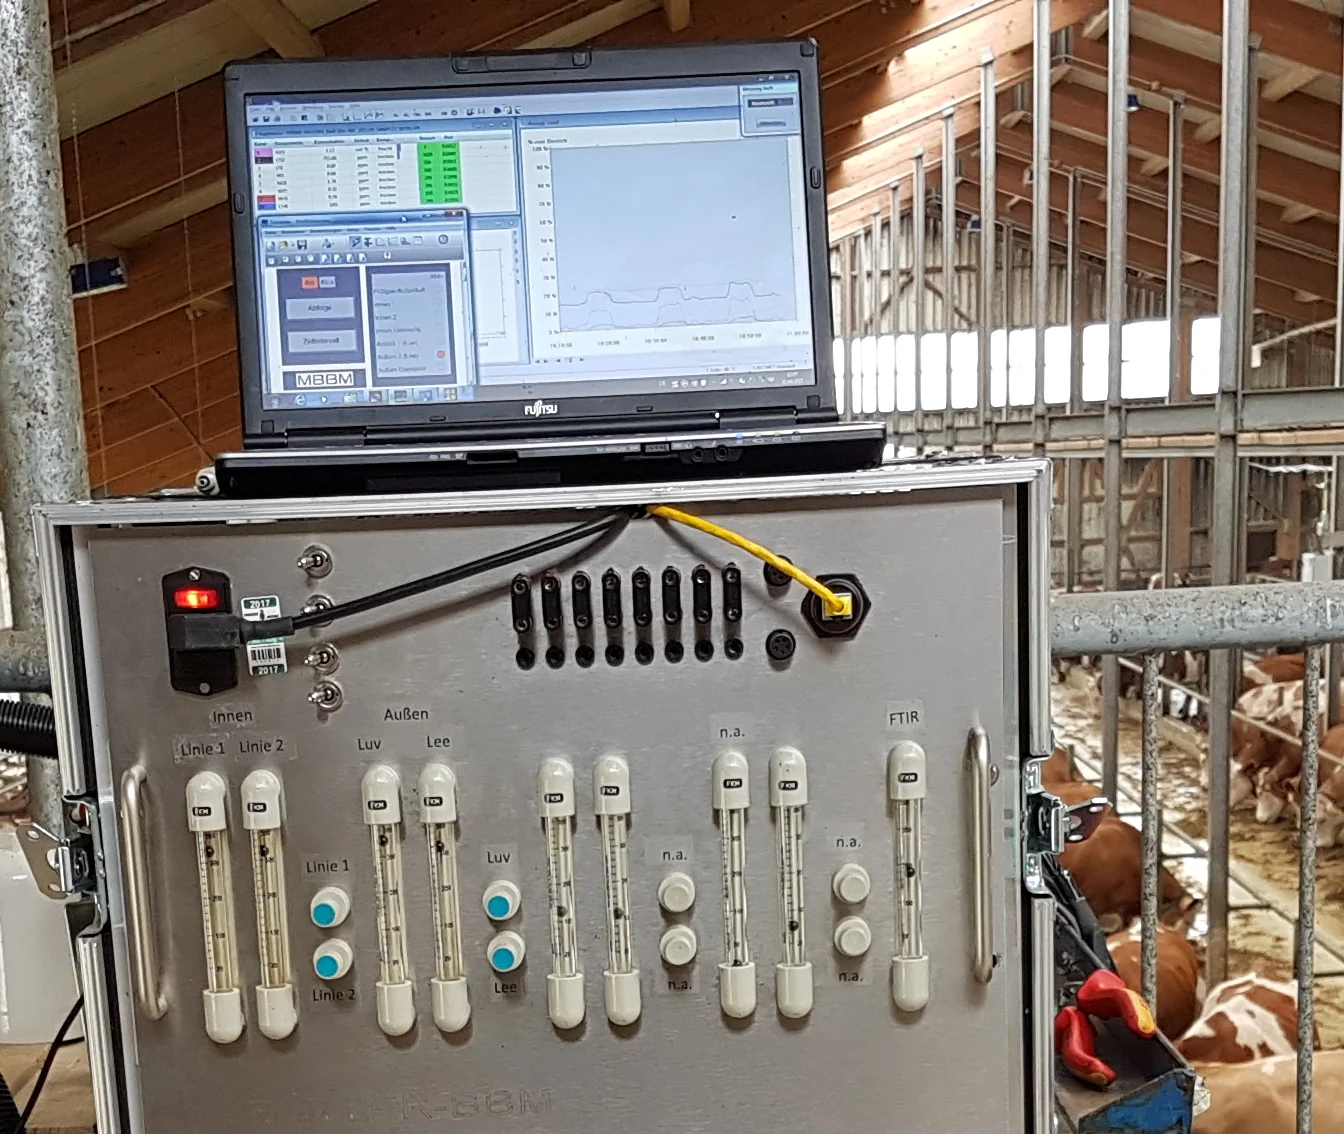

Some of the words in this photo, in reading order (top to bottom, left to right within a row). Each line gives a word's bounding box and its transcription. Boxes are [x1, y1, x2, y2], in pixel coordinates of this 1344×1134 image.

[297, 373, 353, 387] MBBM
[525, 400, 558, 417] FUJITSU
[250, 600, 270, 608] 2017
[258, 666, 278, 675] 2017
[213, 711, 253, 722] Innen
[384, 709, 429, 721] Außen
[889, 711, 919, 726] FTIR
[720, 727, 745, 738] n.a.
[239, 741, 270, 753] Linie
[276, 740, 284, 752] 2
[358, 738, 382, 750] Luv
[427, 735, 451, 748] Lee
[181, 744, 214, 756] Linie
[836, 836, 861, 848] n.a.
[487, 851, 511, 863] Luv
[662, 850, 687, 861] n.a.
[306, 862, 338, 873] Linie
[343, 860, 350, 871] 1
[839, 972, 863, 983] n.a.
[494, 982, 517, 994] Lee
[668, 979, 692, 990] n.a.
[313, 990, 344, 1001] Linie
[347, 989, 355, 1000] 2
